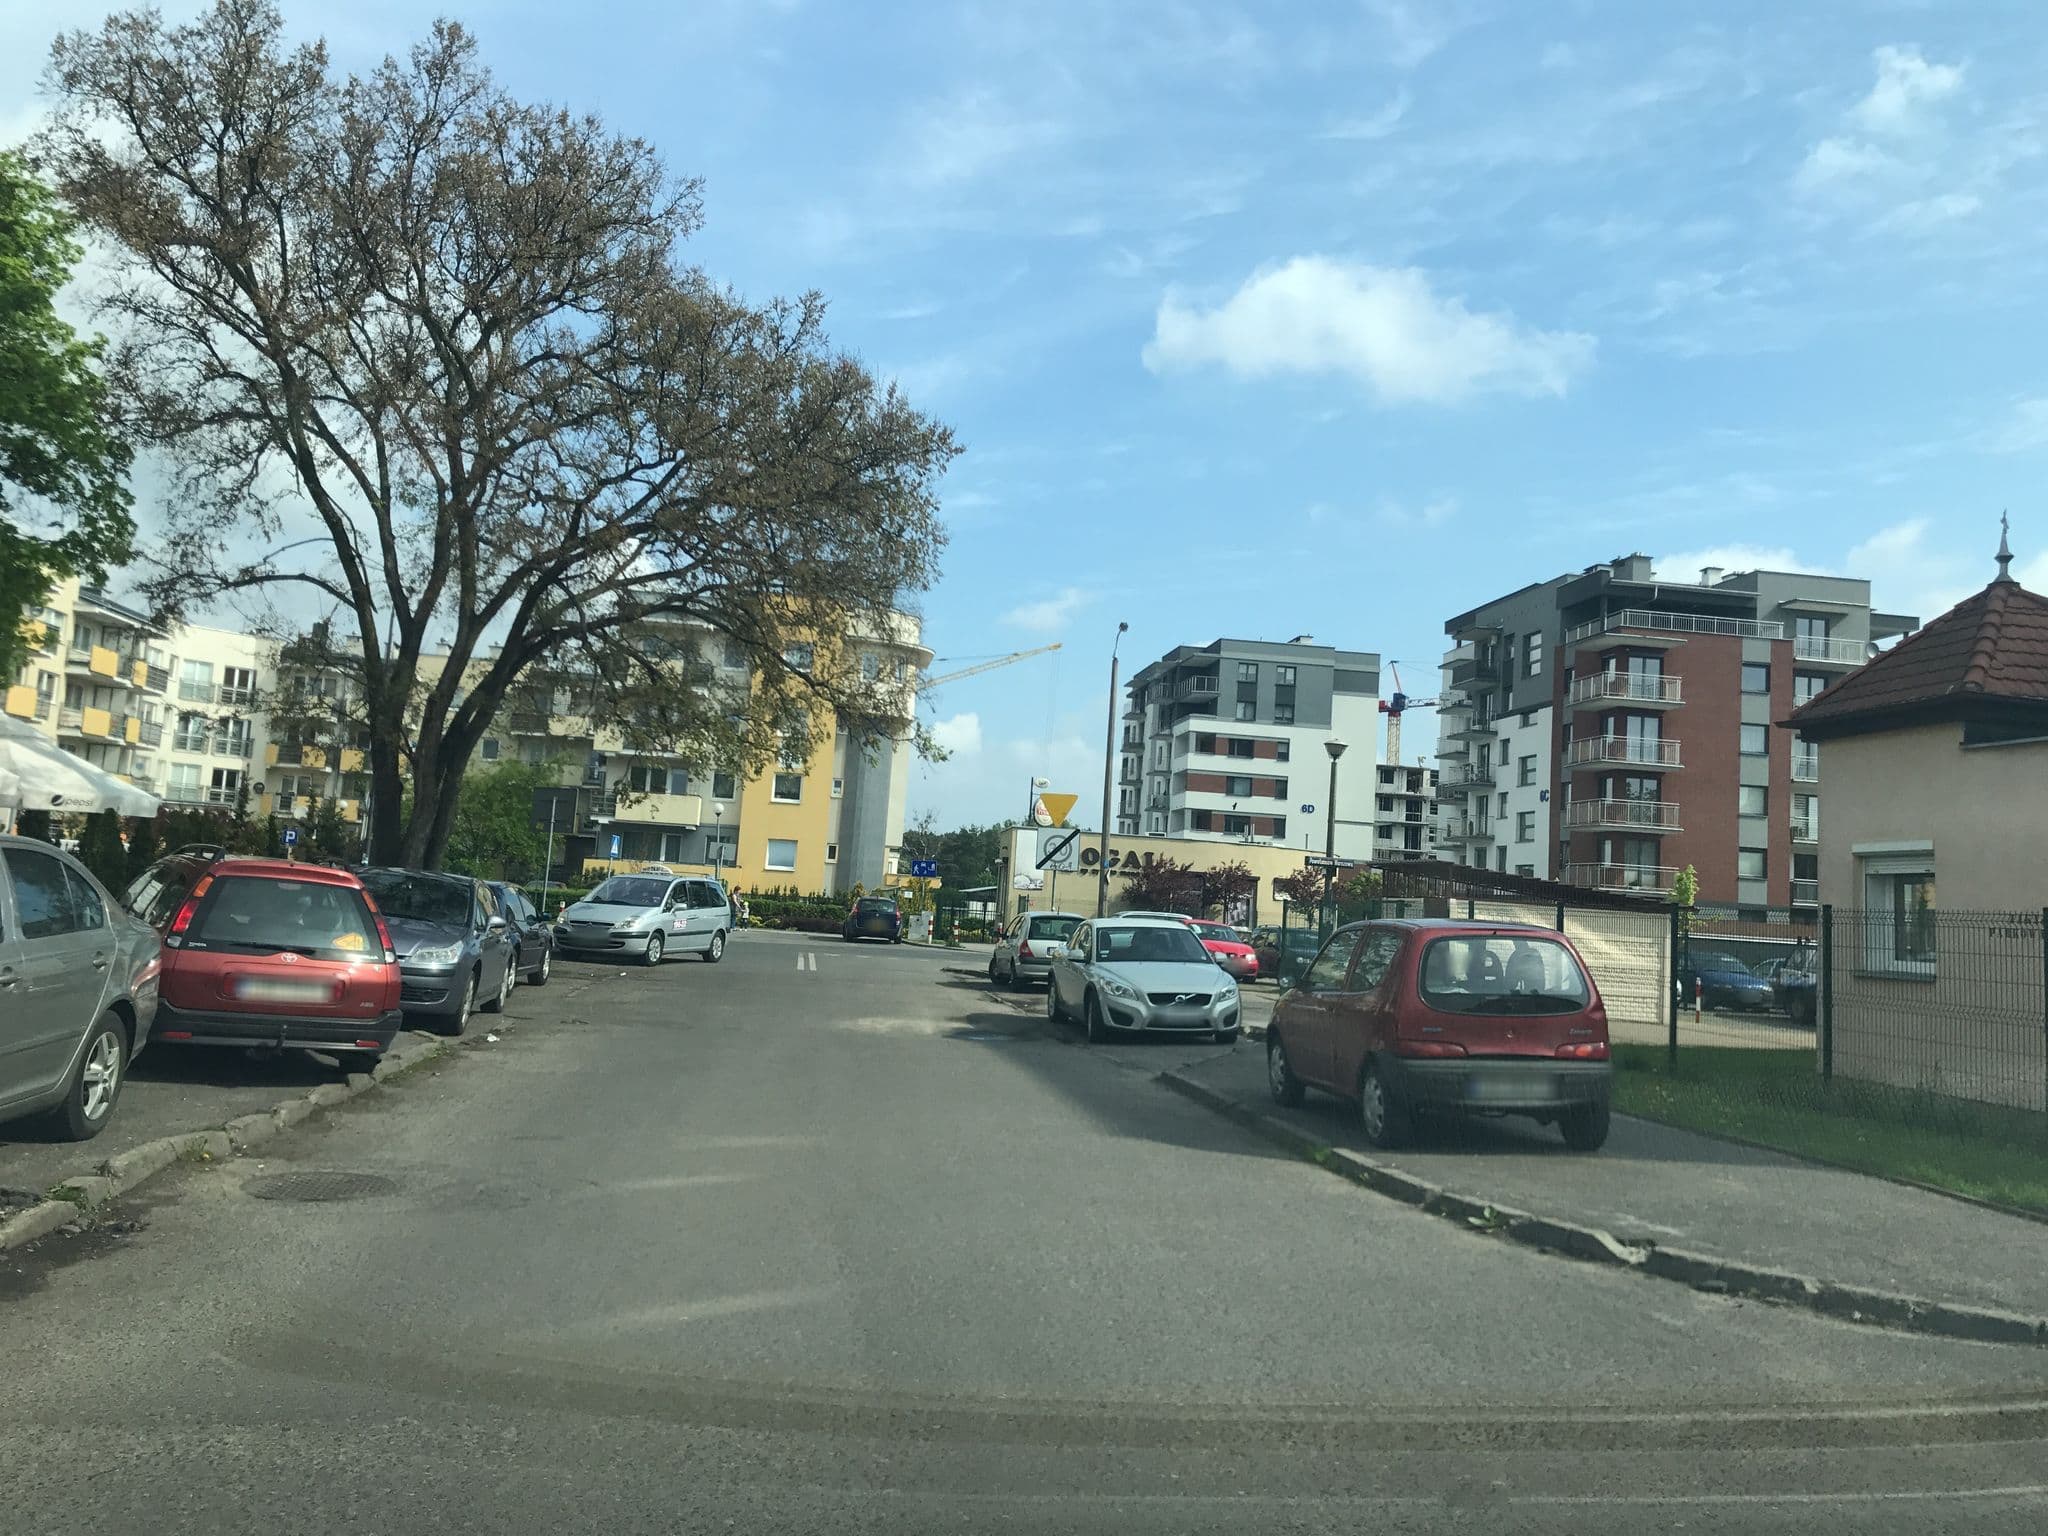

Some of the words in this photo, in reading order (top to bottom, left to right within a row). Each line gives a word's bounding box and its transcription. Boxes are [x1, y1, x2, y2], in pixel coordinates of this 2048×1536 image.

[64, 797, 93, 807] pepsi
[1301, 804, 1315, 814] 6D
[285, 830, 296, 843] P
